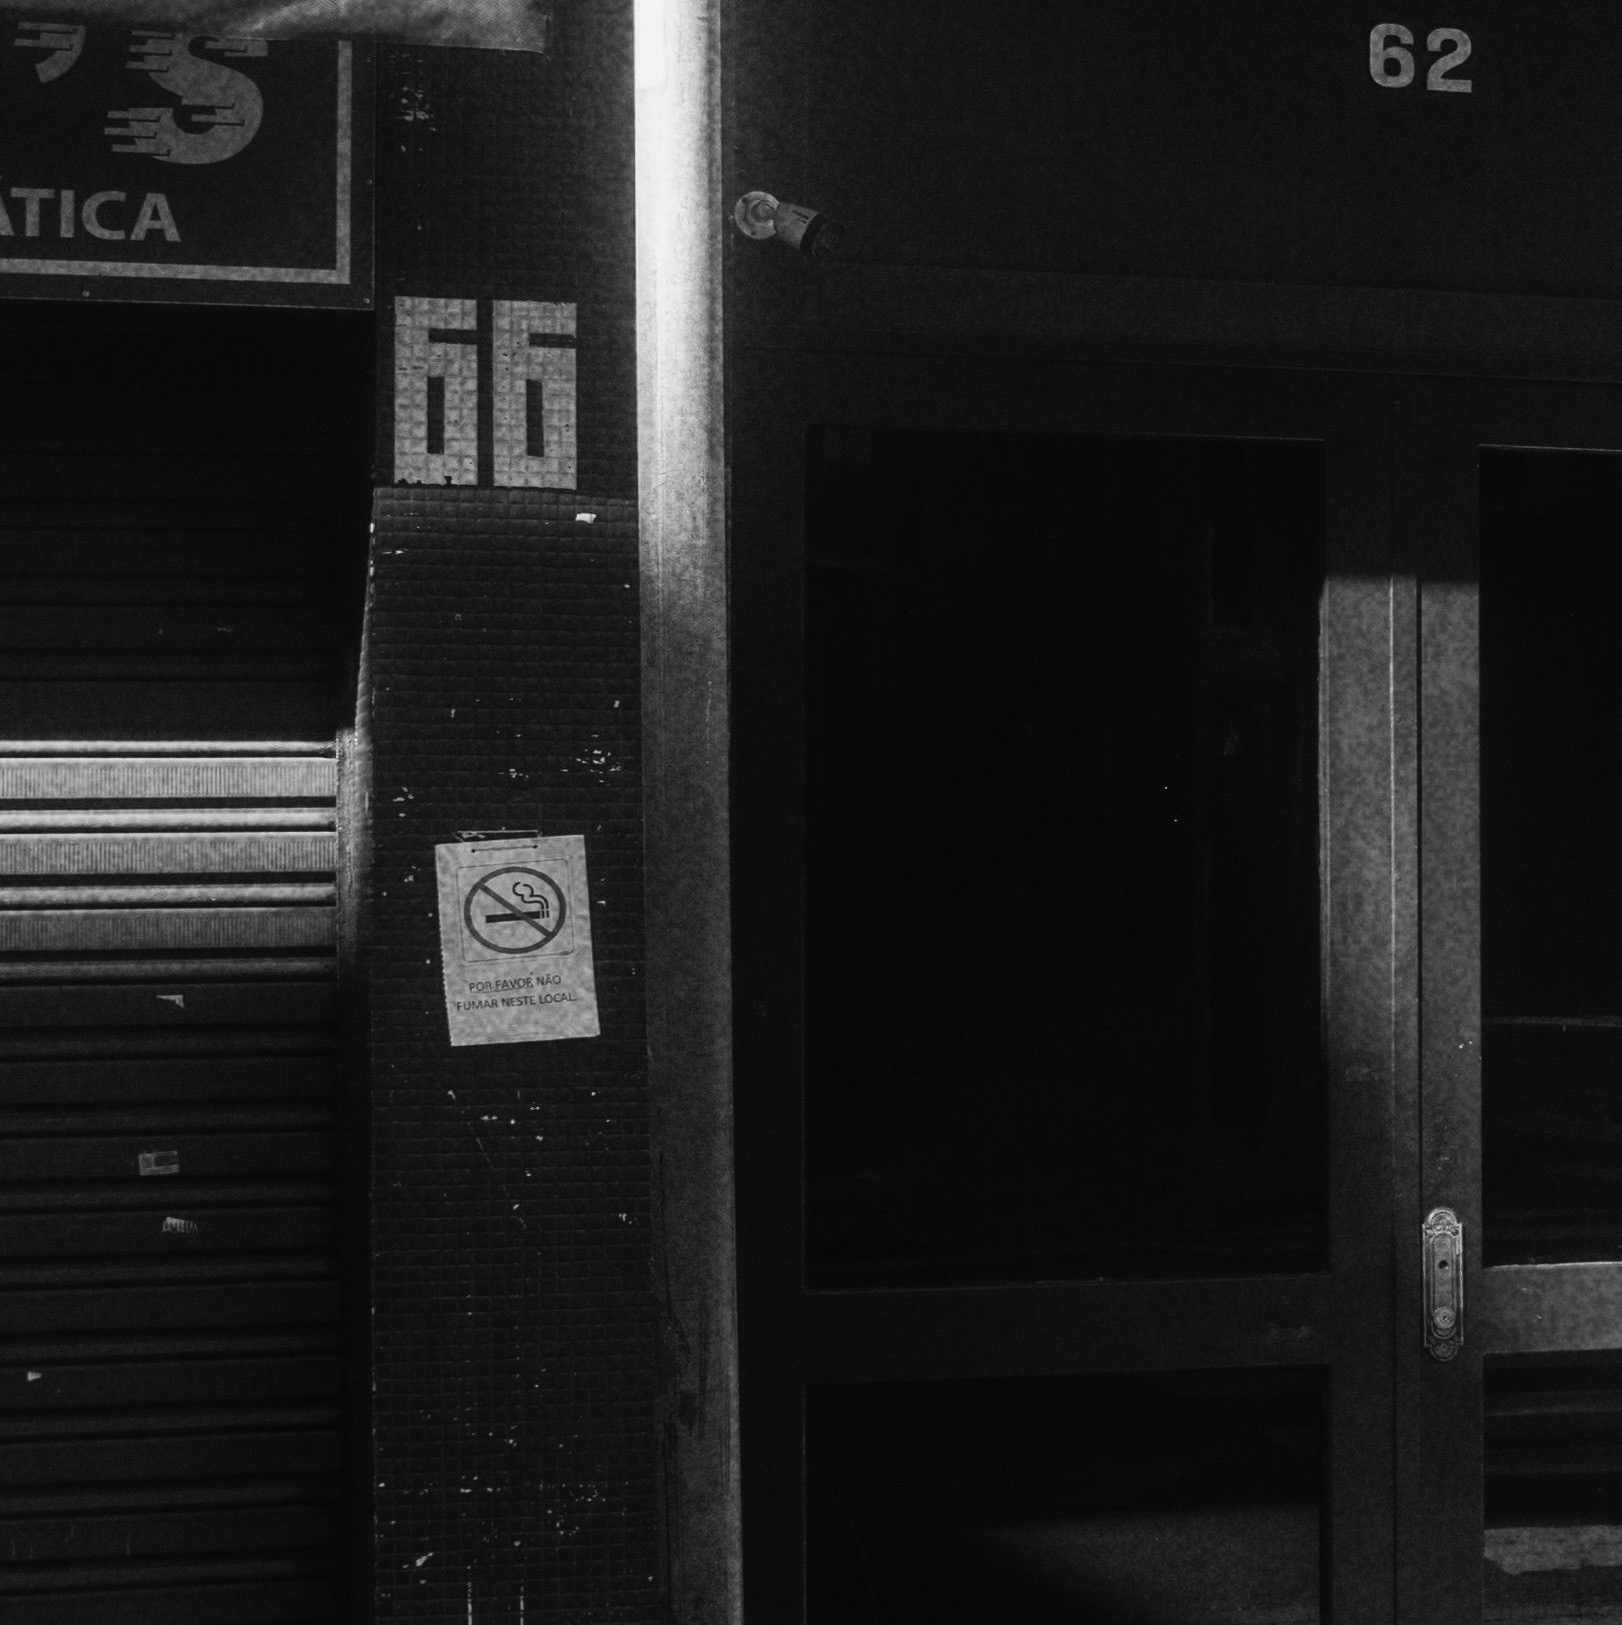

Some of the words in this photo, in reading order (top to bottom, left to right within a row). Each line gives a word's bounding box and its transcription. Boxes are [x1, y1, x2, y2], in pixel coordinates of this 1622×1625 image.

[1369, 22, 1473, 93] 62
[394, 295, 578, 490] 66
[456, 998, 498, 1012] FUMAR
[501, 995, 536, 1008] NESTE
[469, 980, 492, 992] POR
[536, 974, 562, 986] NÃO
